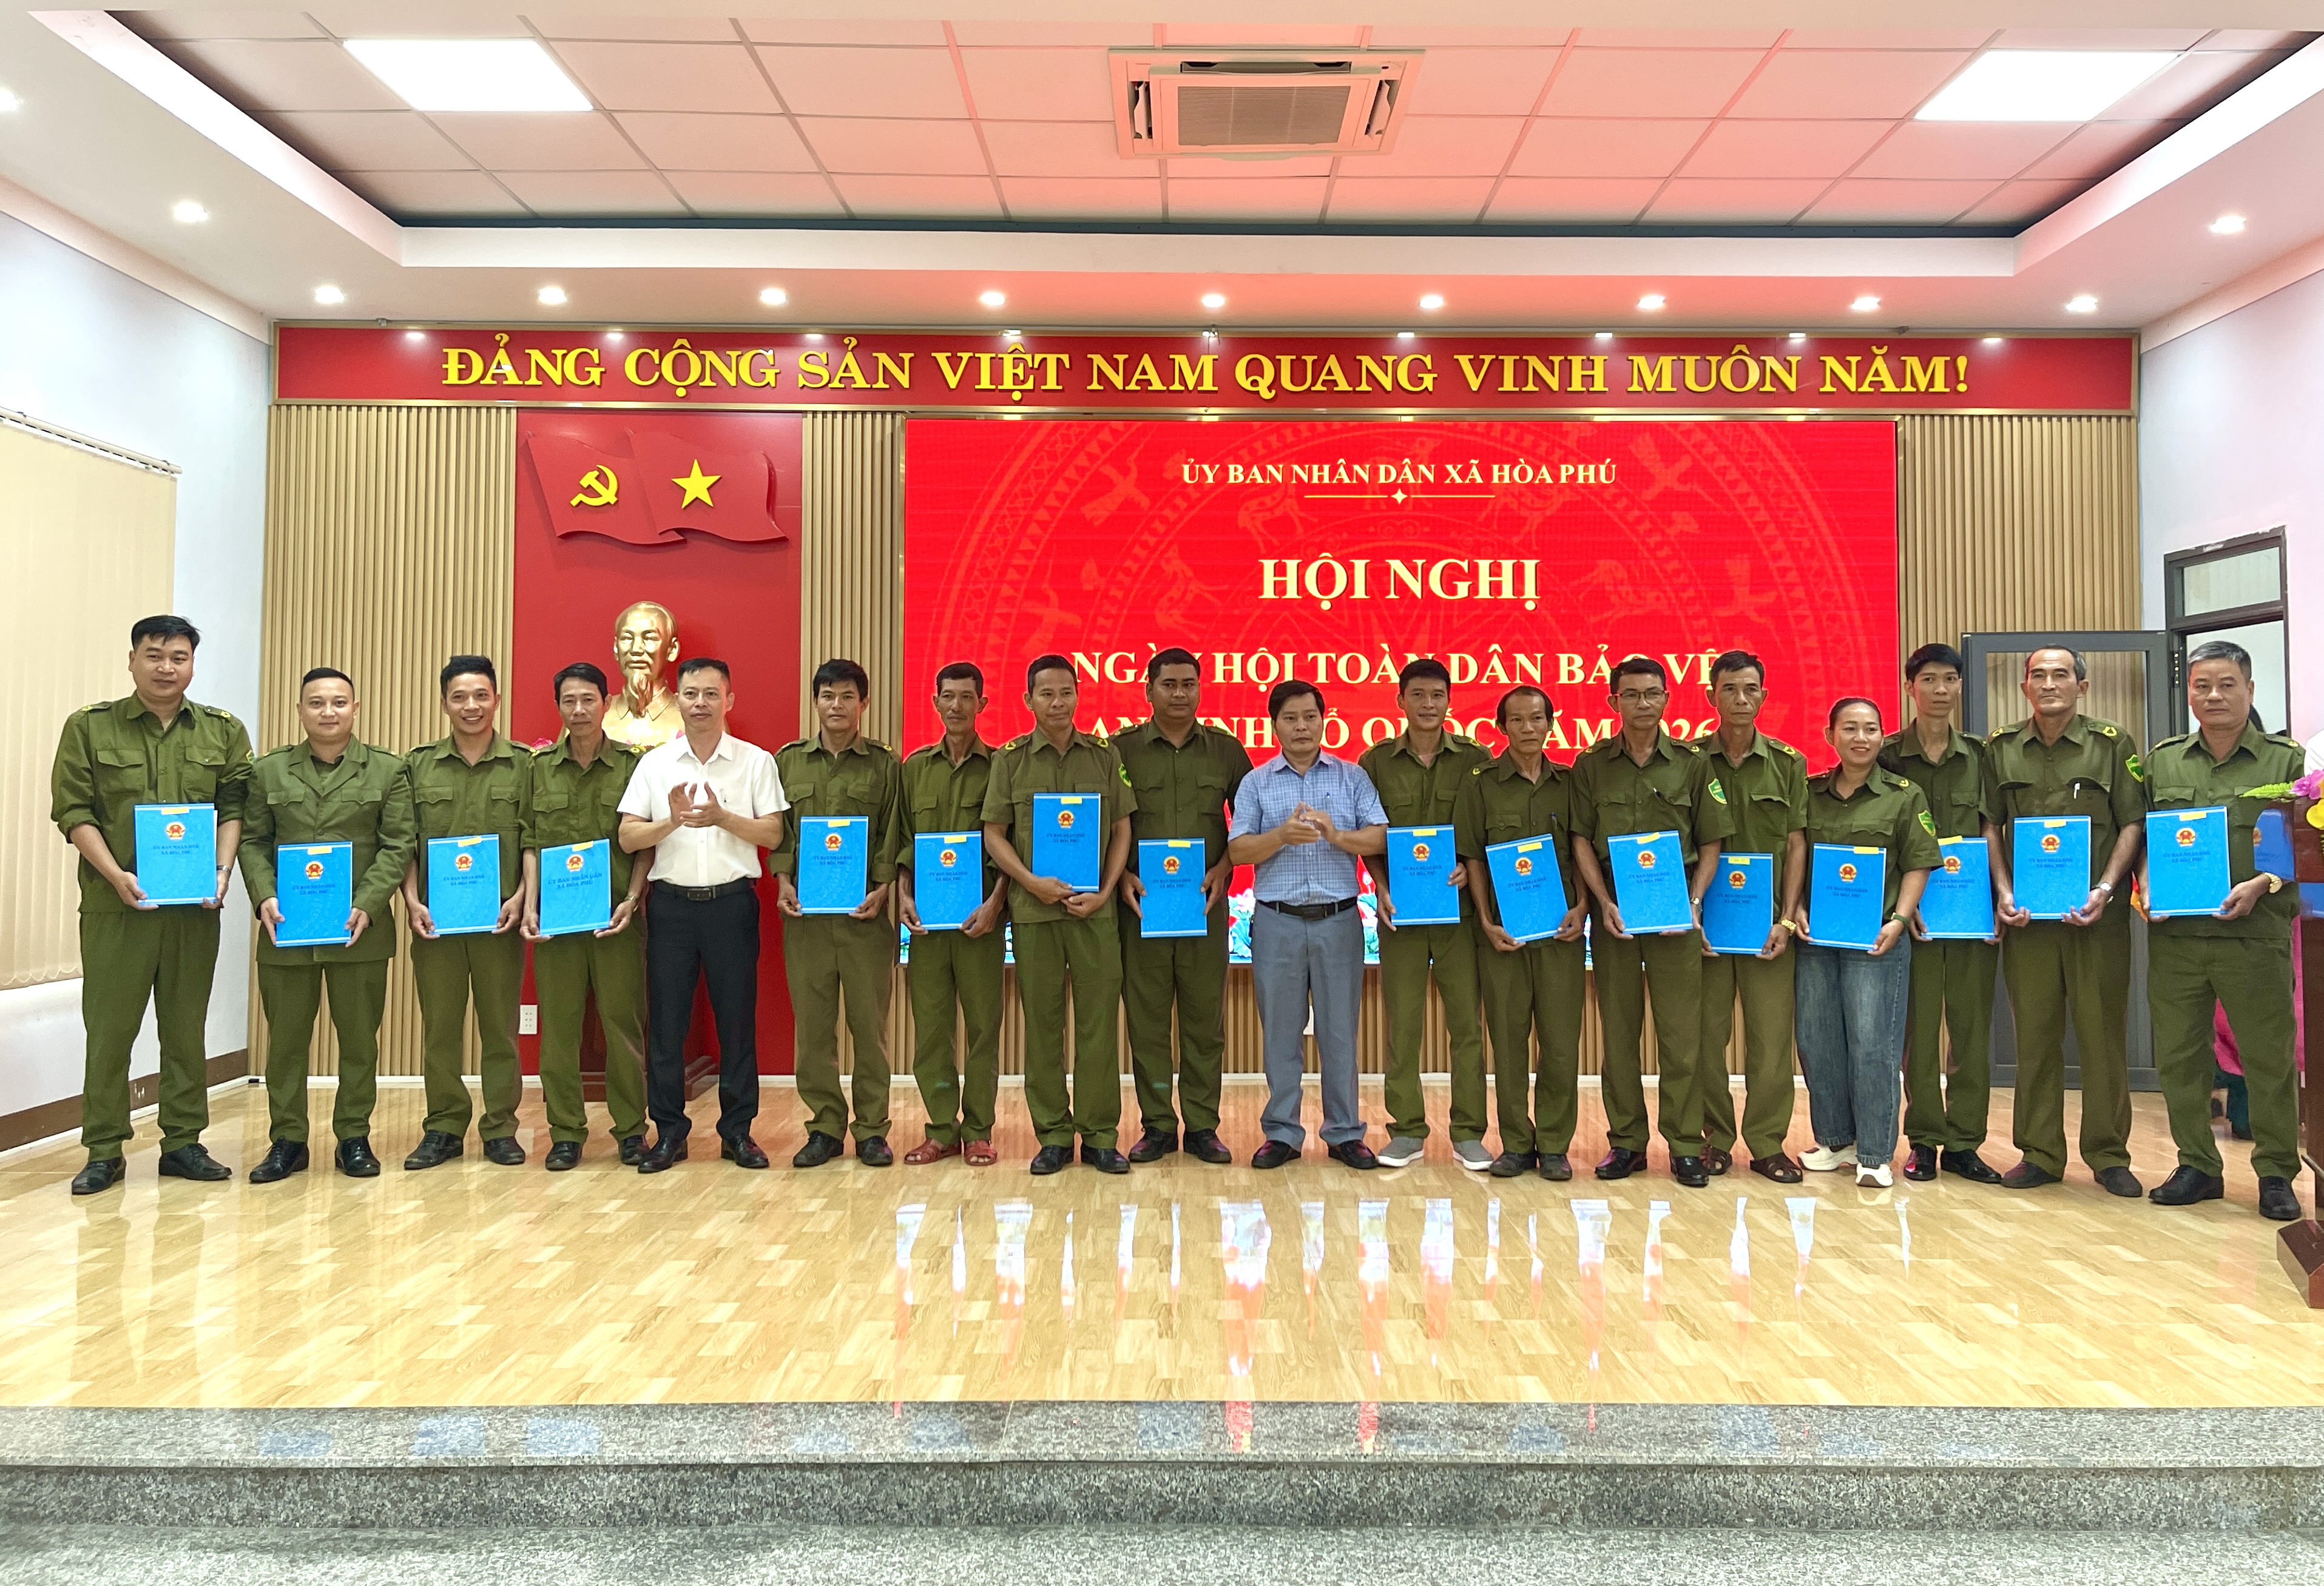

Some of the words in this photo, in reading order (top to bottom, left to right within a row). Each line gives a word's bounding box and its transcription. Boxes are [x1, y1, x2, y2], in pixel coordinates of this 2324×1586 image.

[442, 332, 604, 387] ĐẢNG
[624, 338, 780, 398] CỘNG
[798, 337, 914, 390] SẢN
[931, 342, 1070, 402] VIỆT
[1086, 353, 1219, 391] NAM
[1235, 353, 1438, 400] QUANG
[1454, 354, 1609, 393] VINH
[1627, 344, 1802, 393] MUÔN
[1820, 345, 1968, 393] NĂM!
[1182, 459, 1220, 484] ỦY
[1228, 464, 1284, 484] BAN
[1291, 459, 1371, 484] NHÂN
[1378, 459, 1436, 484] DÂN
[1444, 459, 1484, 484] XÃ
[1491, 458, 1554, 484] HÒA
[1559, 458, 1616, 484] PHÚ
[1258, 552, 1371, 610] HỘI
[1385, 559, 1541, 610] NGHỊ
[1071, 643, 1202, 683] NG
[1212, 647, 1297, 692] HỘI
[1308, 643, 1436, 684] TOÀ
[1446, 644, 1543, 684] DÂN
[1556, 644, 1651, 684] BẢ
[1542, 709, 1615, 749] ĂM
